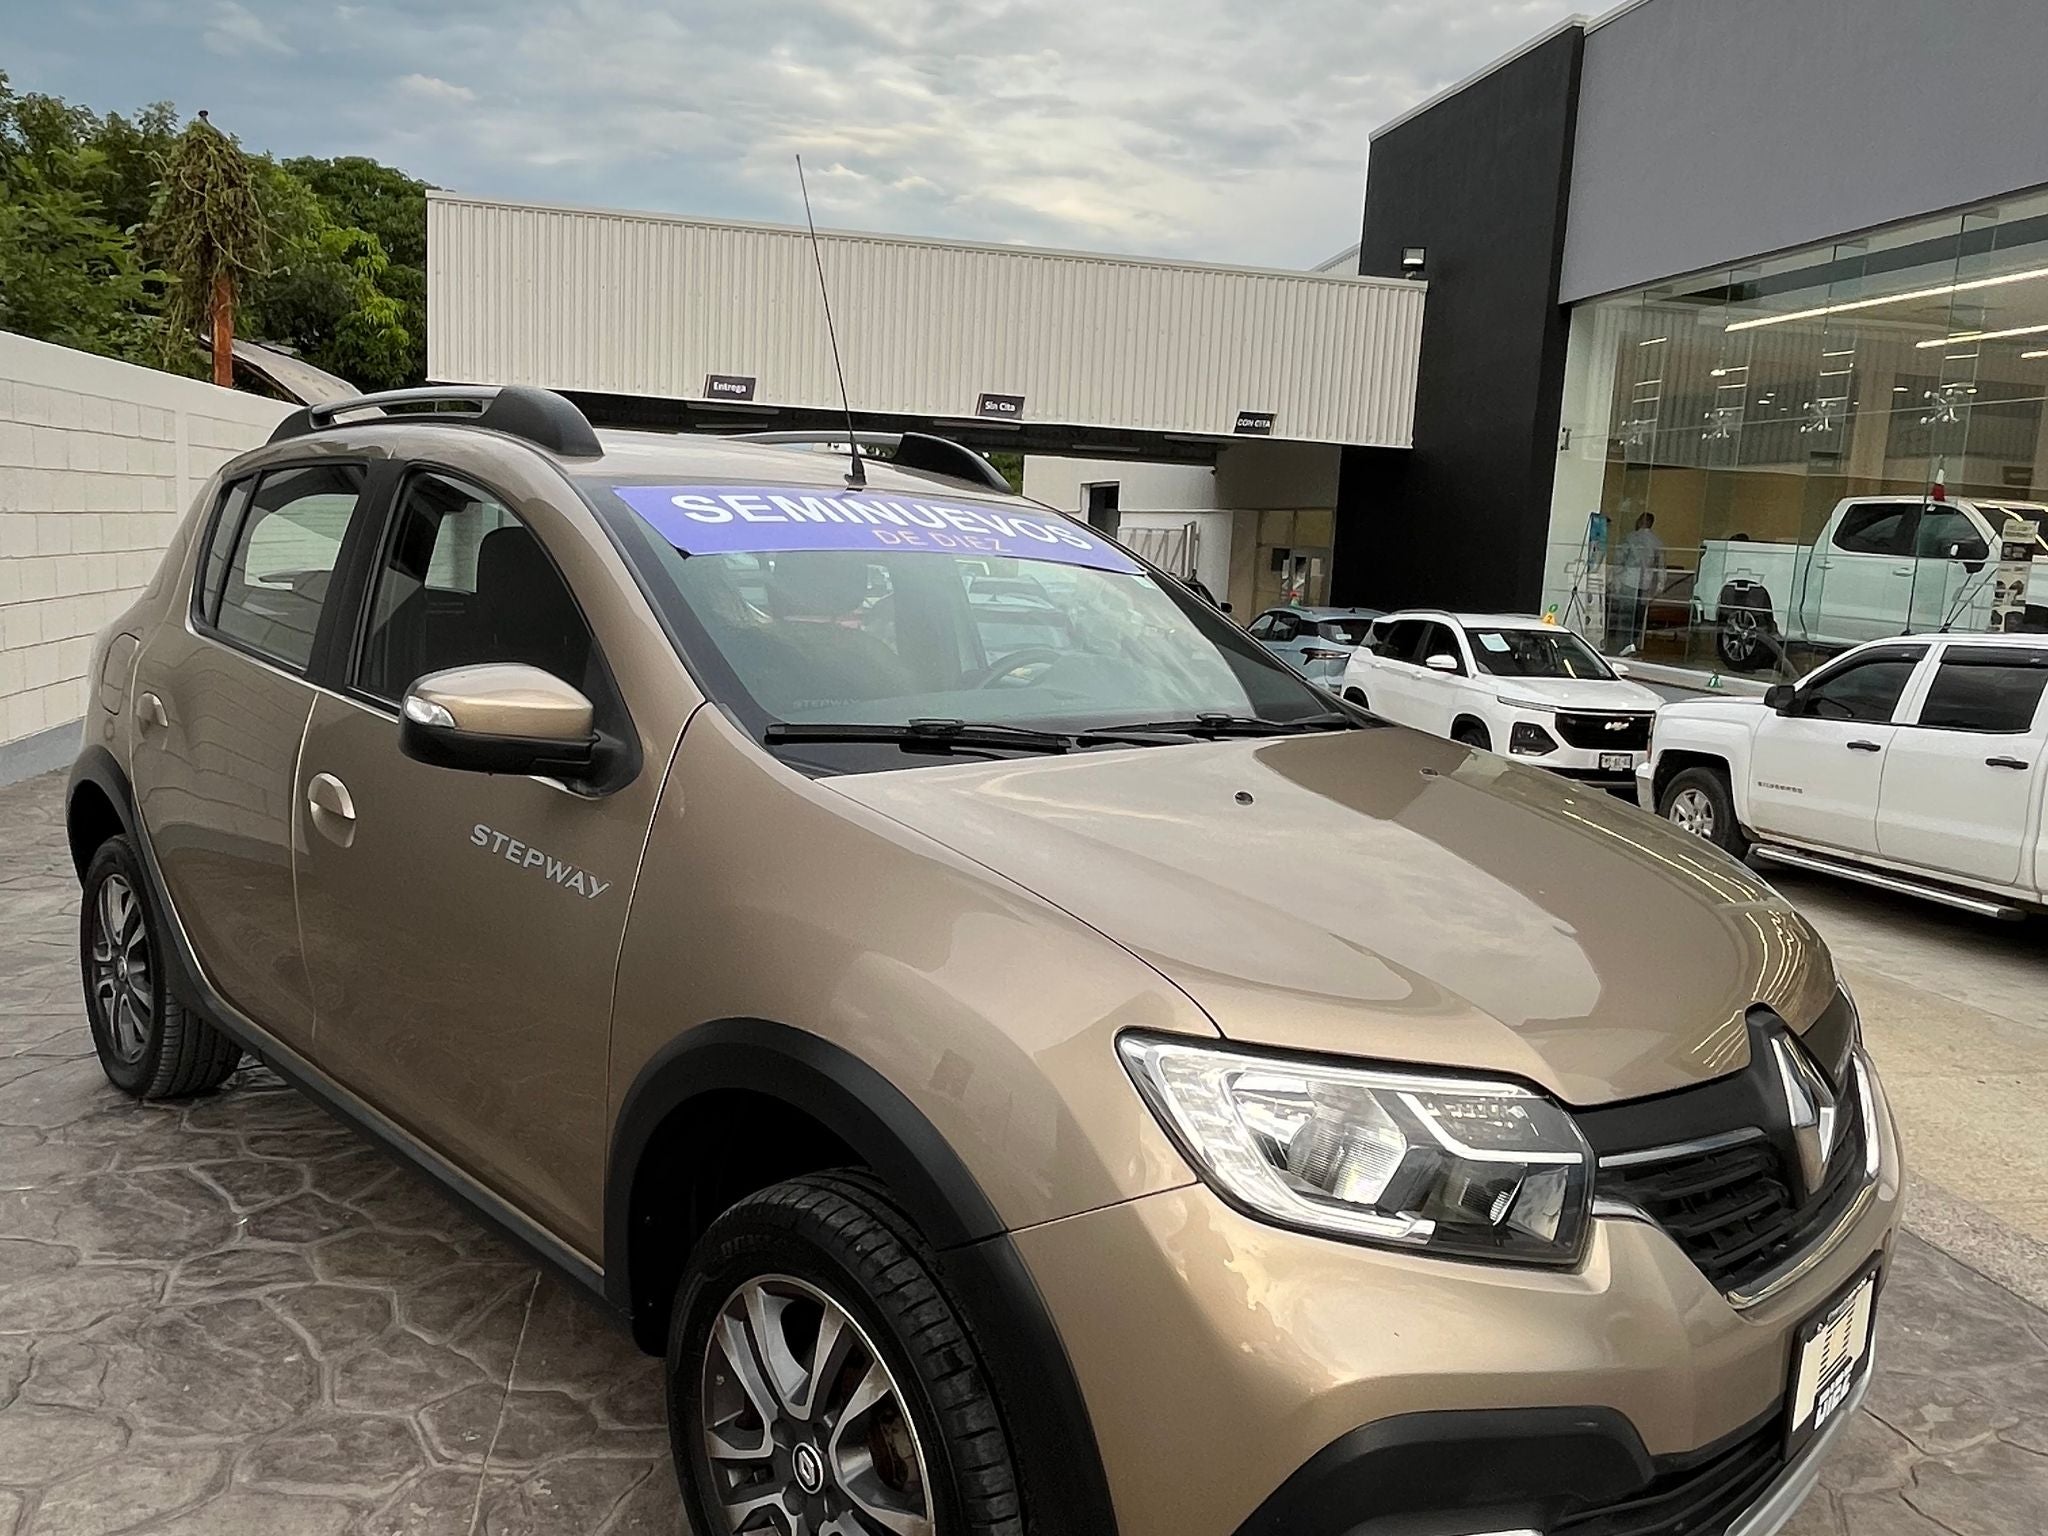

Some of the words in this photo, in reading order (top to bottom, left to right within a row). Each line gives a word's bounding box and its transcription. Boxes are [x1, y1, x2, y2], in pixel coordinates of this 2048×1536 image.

[713, 381, 747, 394] Entrega
[985, 400, 999, 410] Sin
[1237, 418, 1254, 427] CON
[1254, 419, 1271, 428] CITA
[671, 494, 1094, 550] SEMINUEVOS
[872, 529, 928, 546] DE
[928, 531, 1012, 552] DIEZ
[470, 823, 610, 899] STEPWAY
